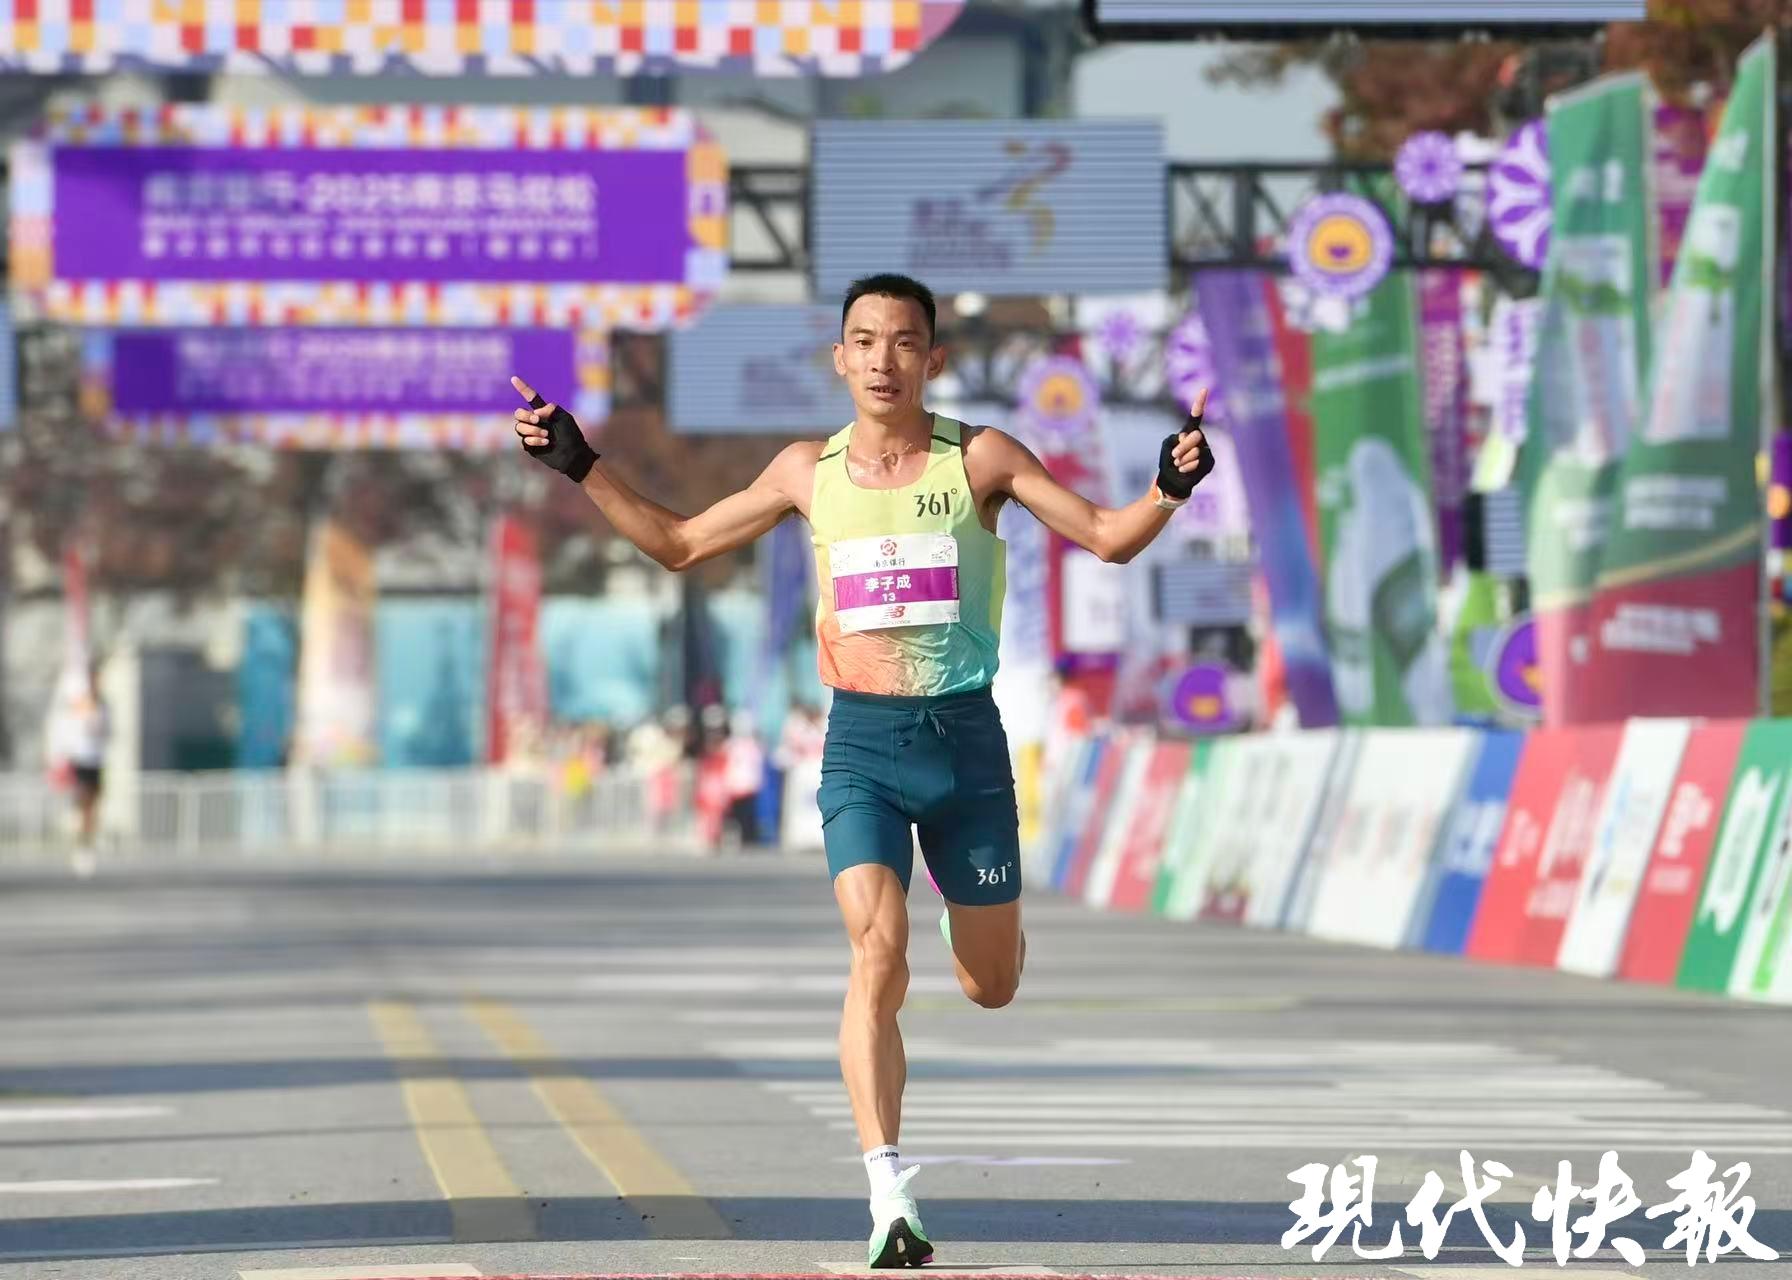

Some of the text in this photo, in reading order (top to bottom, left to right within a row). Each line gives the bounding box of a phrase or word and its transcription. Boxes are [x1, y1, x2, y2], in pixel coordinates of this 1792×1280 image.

[913, 488, 958, 518] 361°
[864, 574, 912, 592] 李子成
[882, 593, 896, 602] 13
[977, 861, 1012, 886] 361°
